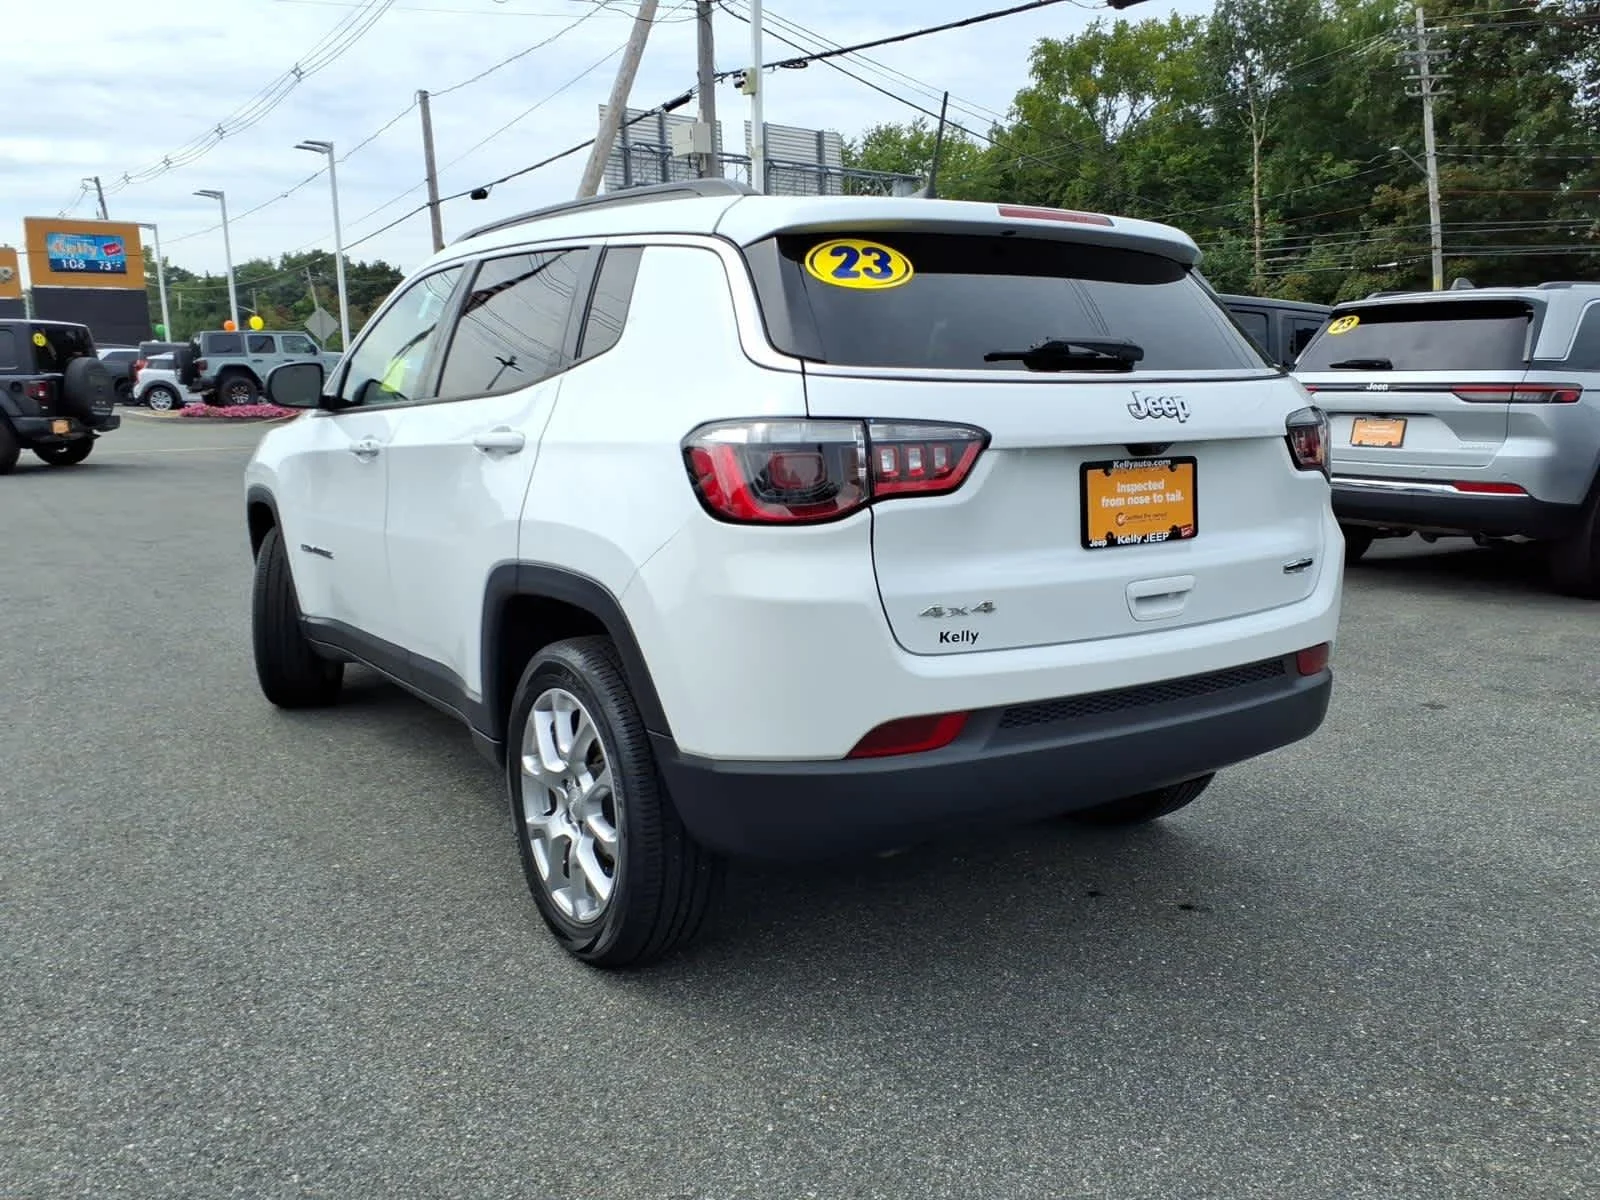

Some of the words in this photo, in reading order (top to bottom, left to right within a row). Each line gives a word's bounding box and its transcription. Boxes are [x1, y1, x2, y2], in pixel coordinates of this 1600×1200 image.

[830, 245, 894, 280] 23
[1332, 317, 1355, 331] 23
[1366, 382, 1389, 391] Jeep
[1128, 391, 1191, 423] Jeep
[1113, 459, 1171, 470] Kellyauto.com
[1117, 479, 1164, 493] Inspected
[1101, 496, 1125, 508] from
[1127, 494, 1150, 505] nose
[1152, 493, 1164, 504] to
[1166, 490, 1184, 502] tail.
[1089, 538, 1107, 548] Jeep
[1117, 534, 1142, 545] Kelly
[1143, 532, 1169, 543] JEEP
[939, 630, 979, 645] Kelly
